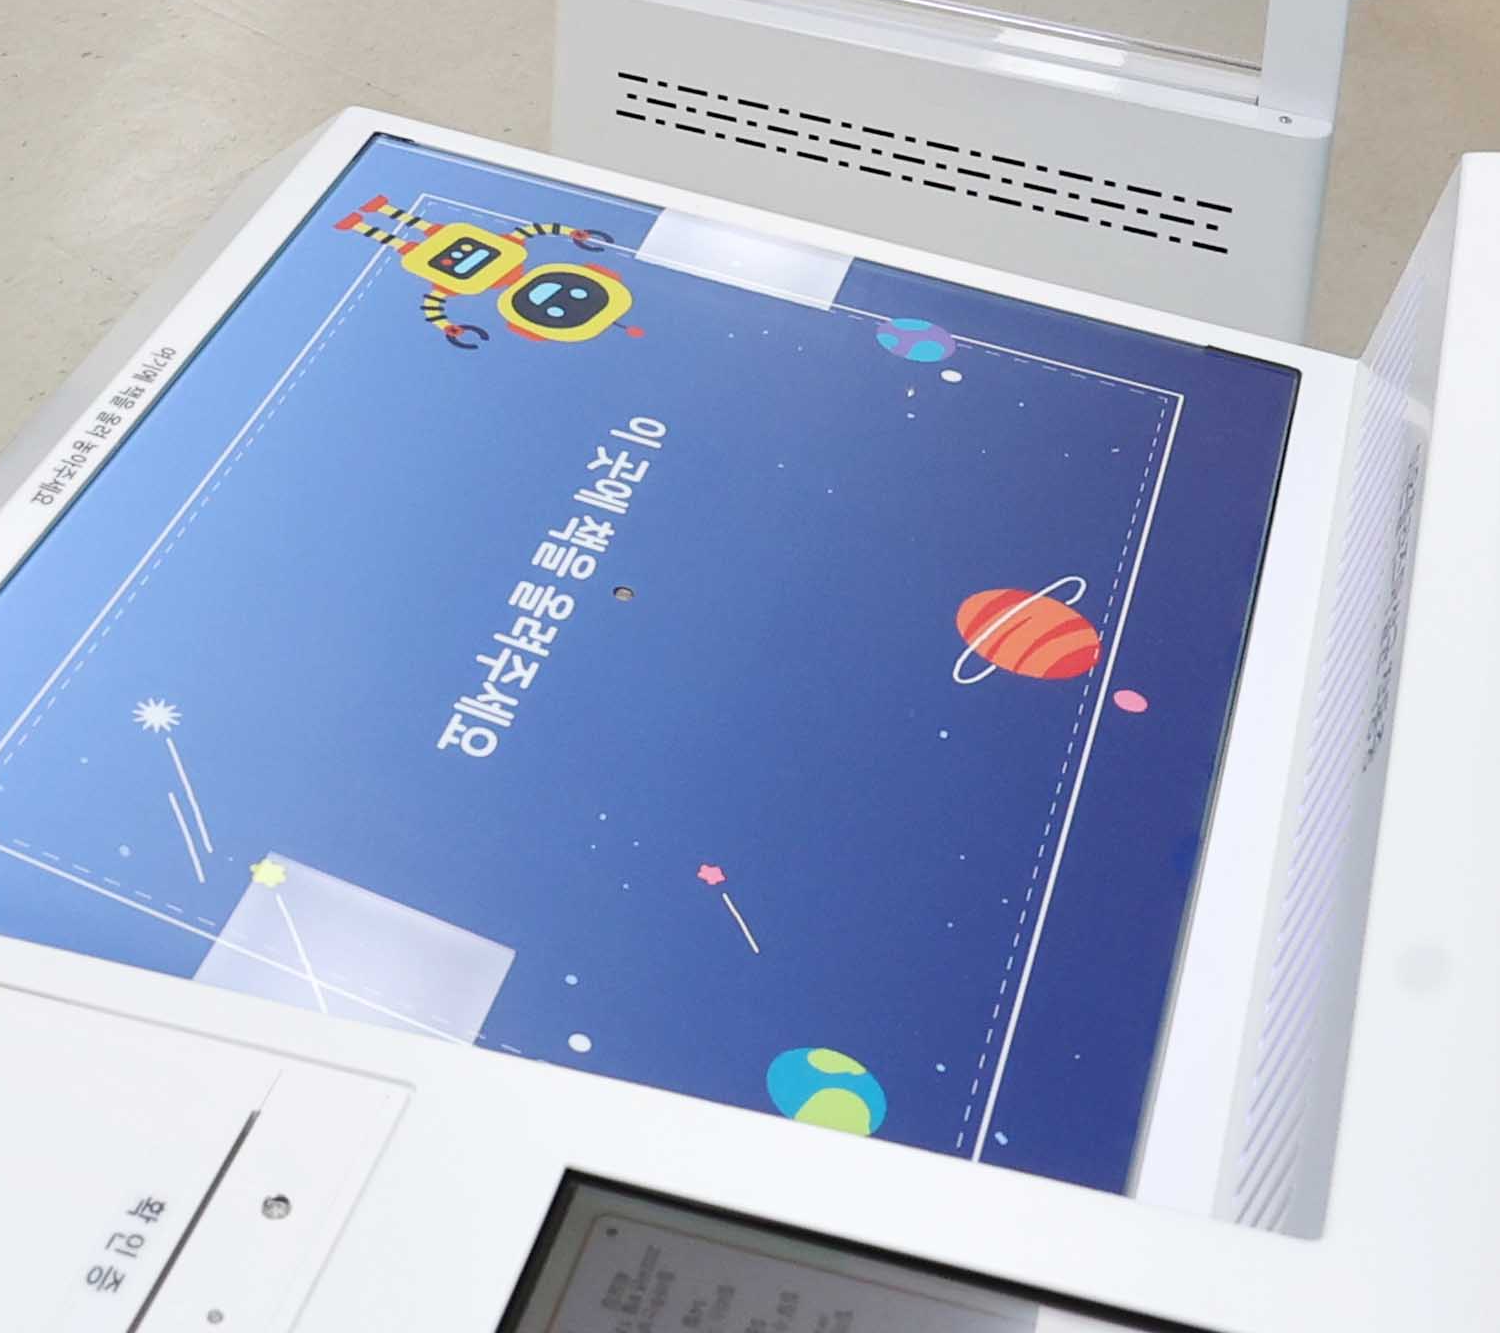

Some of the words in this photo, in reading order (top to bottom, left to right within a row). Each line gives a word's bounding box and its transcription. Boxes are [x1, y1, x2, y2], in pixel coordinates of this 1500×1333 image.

[132, 346, 177, 383] 여기에
[85, 411, 122, 439] 올려
[109, 386, 146, 410] 책을
[609, 416, 667, 450] 이
[30, 440, 100, 506] 놓아주세요
[573, 445, 650, 515] 곳에
[530, 515, 616, 581] 책을
[436, 580, 575, 758] 올려주세요
[85, 1196, 167, 1294] 확인증
